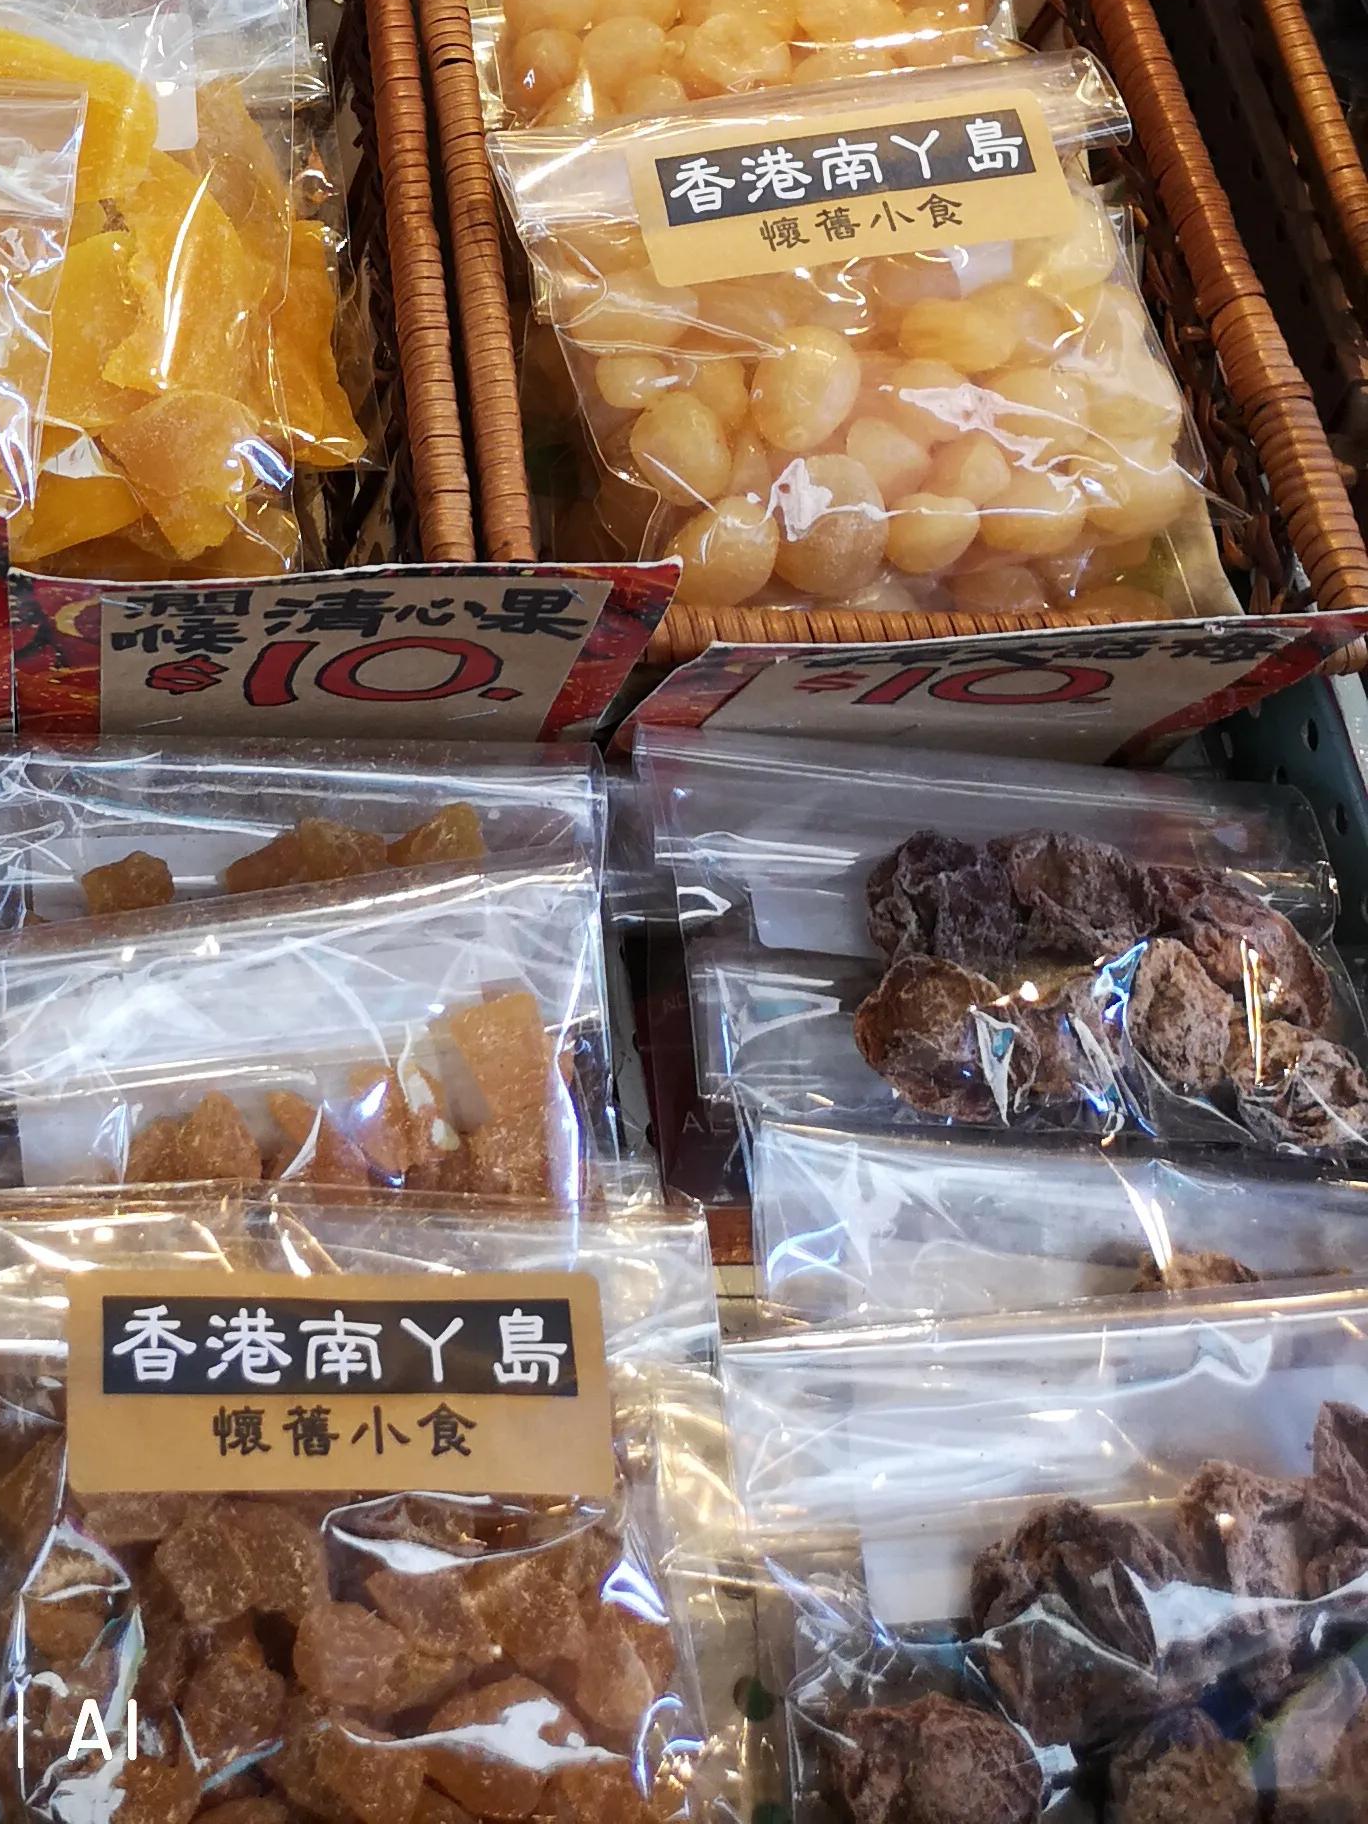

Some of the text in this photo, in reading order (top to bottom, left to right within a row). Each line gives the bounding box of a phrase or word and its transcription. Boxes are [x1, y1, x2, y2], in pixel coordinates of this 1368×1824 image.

[669, 117, 1024, 215] 香港南丫島
[758, 193, 964, 253] 懷舊小食
[145, 636, 525, 707] $10.
[112, 1304, 568, 1386] 香港南丫島
[213, 1403, 479, 1458] 懷舊小食
